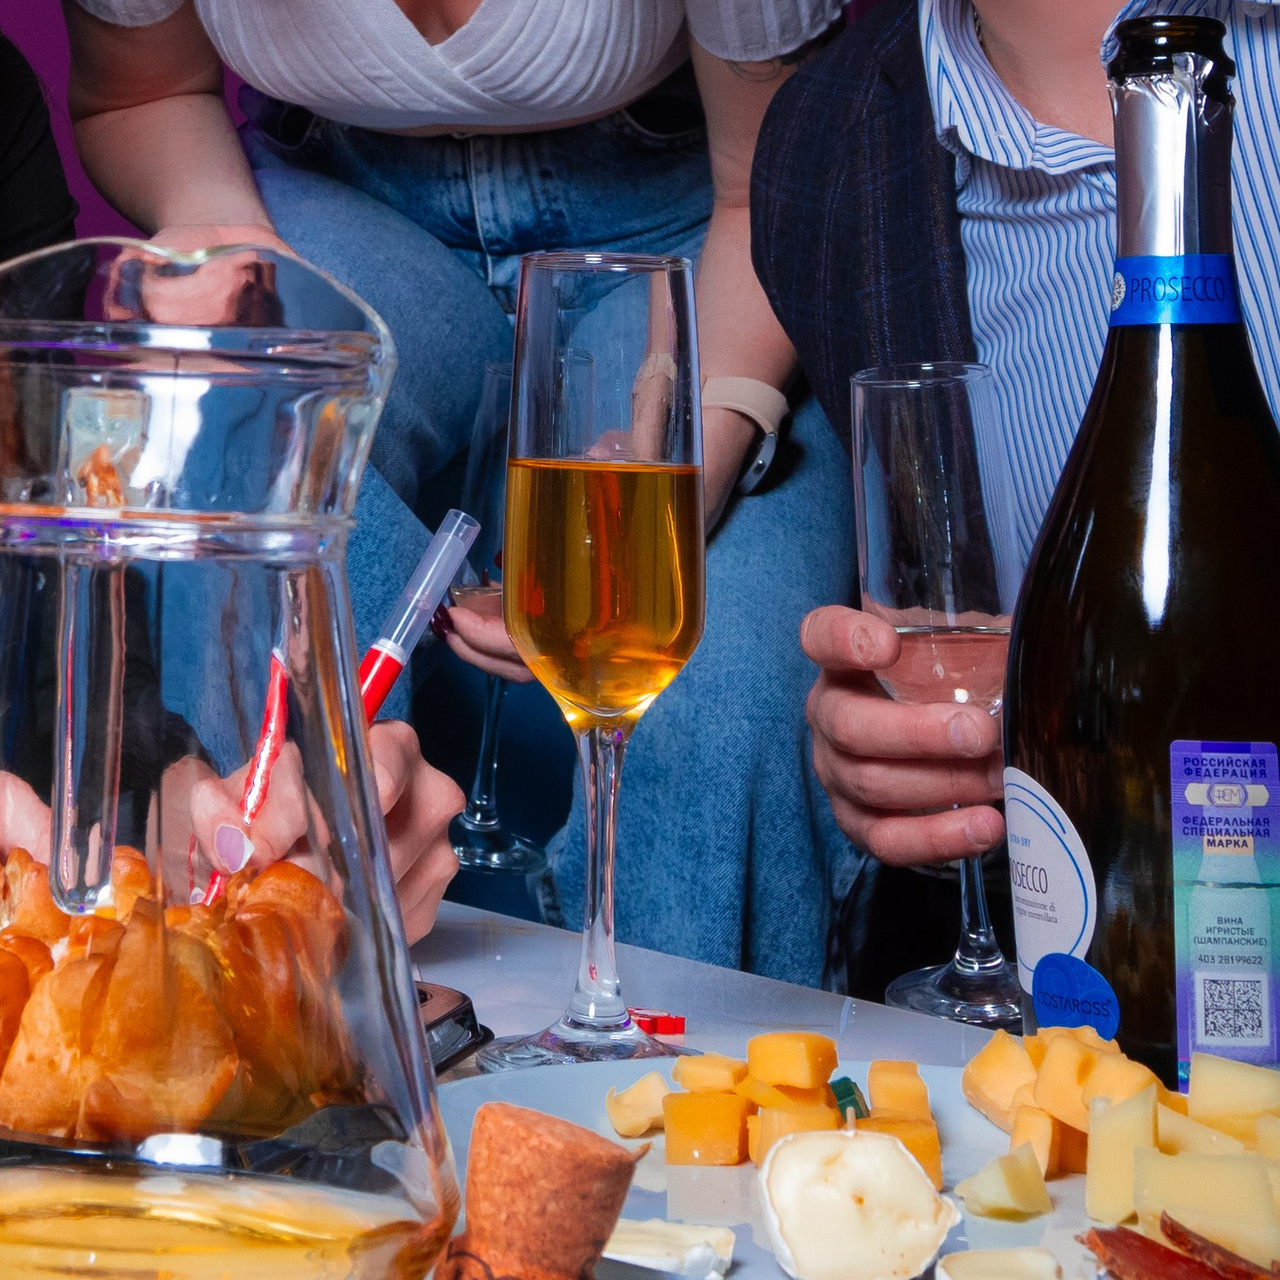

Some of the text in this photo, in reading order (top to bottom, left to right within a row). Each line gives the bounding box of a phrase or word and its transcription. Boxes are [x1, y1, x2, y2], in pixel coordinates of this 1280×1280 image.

[1130, 276, 1225, 302] PROSECCO
[1184, 756, 1266, 768] РОССИЙСКАЯ
[1184, 768, 1267, 779] ФЕДЕРАЦИЯ
[1182, 816, 1270, 826] ФЕДЕРАЛЬНАЯ
[1182, 826, 1270, 838] СПЕЦИАЛЬНАЯ
[1206, 838, 1248, 848] МАРКА
[1217, 916, 1244, 925] ВИНА
[1206, 926, 1255, 936] ИГРИСТЫЕ
[1194, 936, 1268, 947] (ШАМПАНСКИЕ)
[1198, 954, 1216, 964] 403
